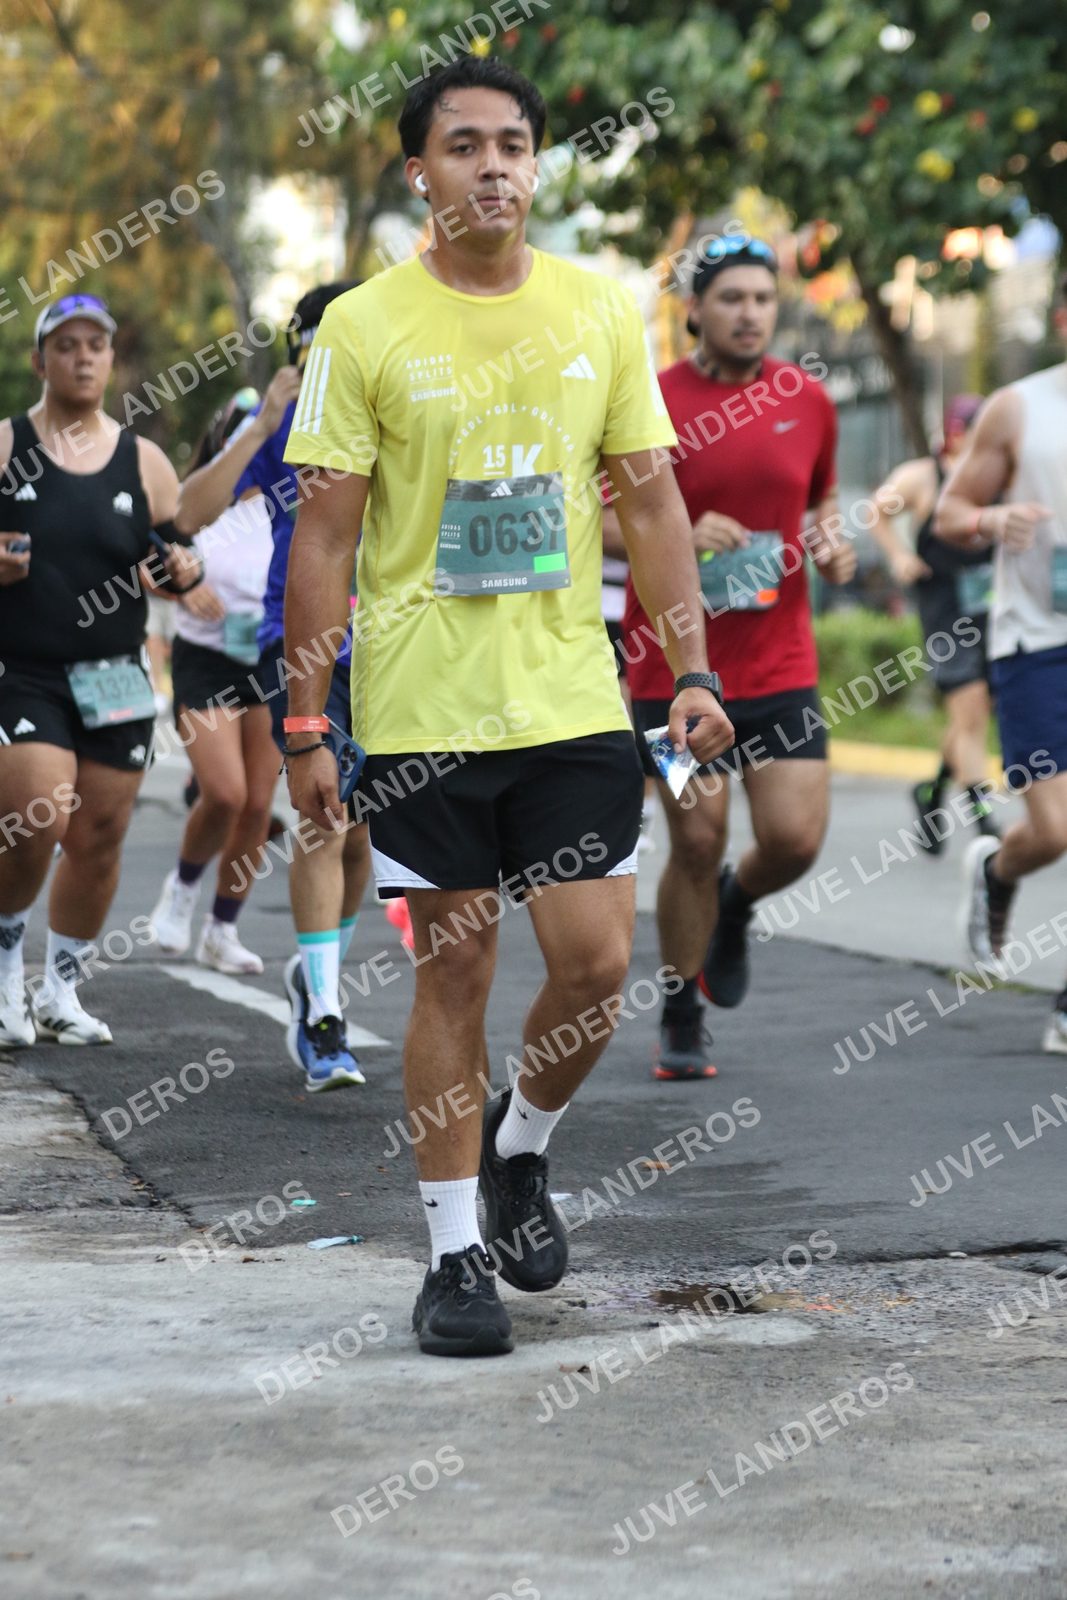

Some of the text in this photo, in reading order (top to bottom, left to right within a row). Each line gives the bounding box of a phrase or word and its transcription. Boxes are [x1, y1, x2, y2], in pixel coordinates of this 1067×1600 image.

[482, 444, 507, 468] 15
[511, 443, 544, 478] K
[468, 508, 563, 557] 0637
[481, 576, 528, 588] SAMSUNG
